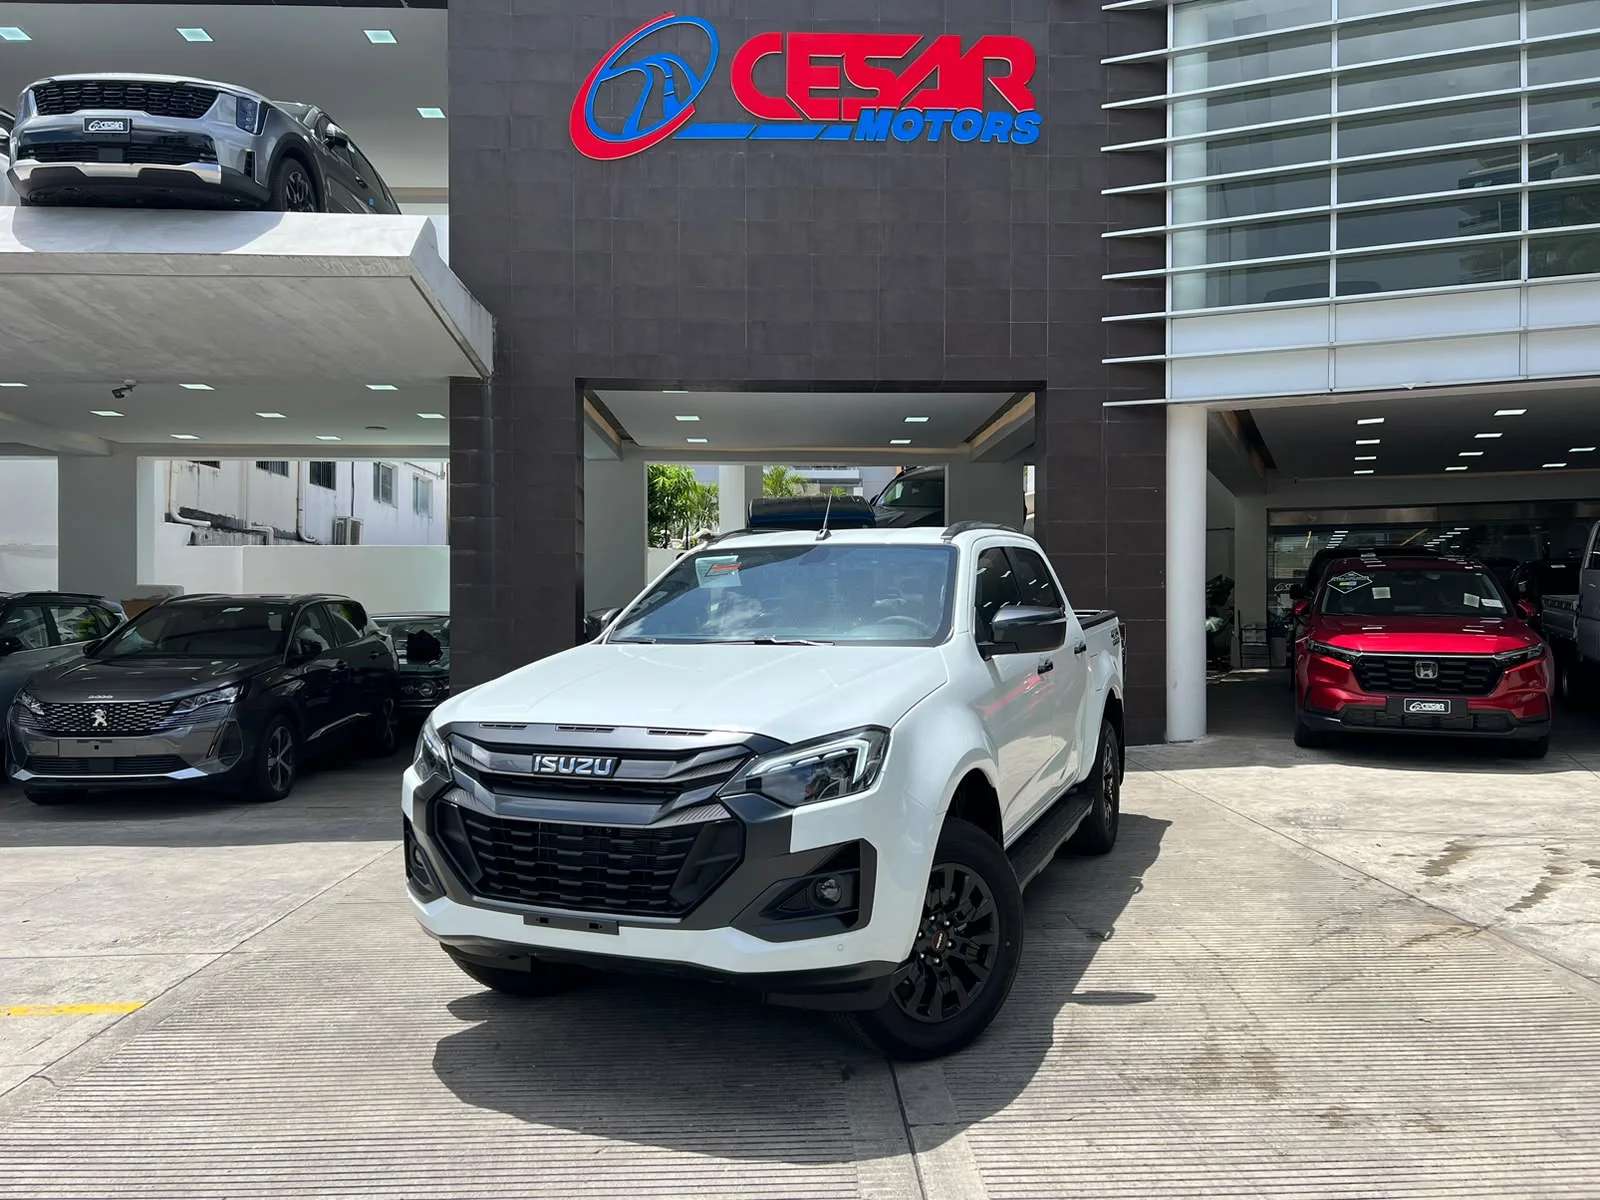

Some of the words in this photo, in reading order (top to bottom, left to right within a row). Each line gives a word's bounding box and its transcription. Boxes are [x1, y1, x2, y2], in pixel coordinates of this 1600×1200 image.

[730, 31, 1037, 120] CESAR
[854, 108, 1042, 144] MOTORS
[533, 755, 612, 775] ISUZU
